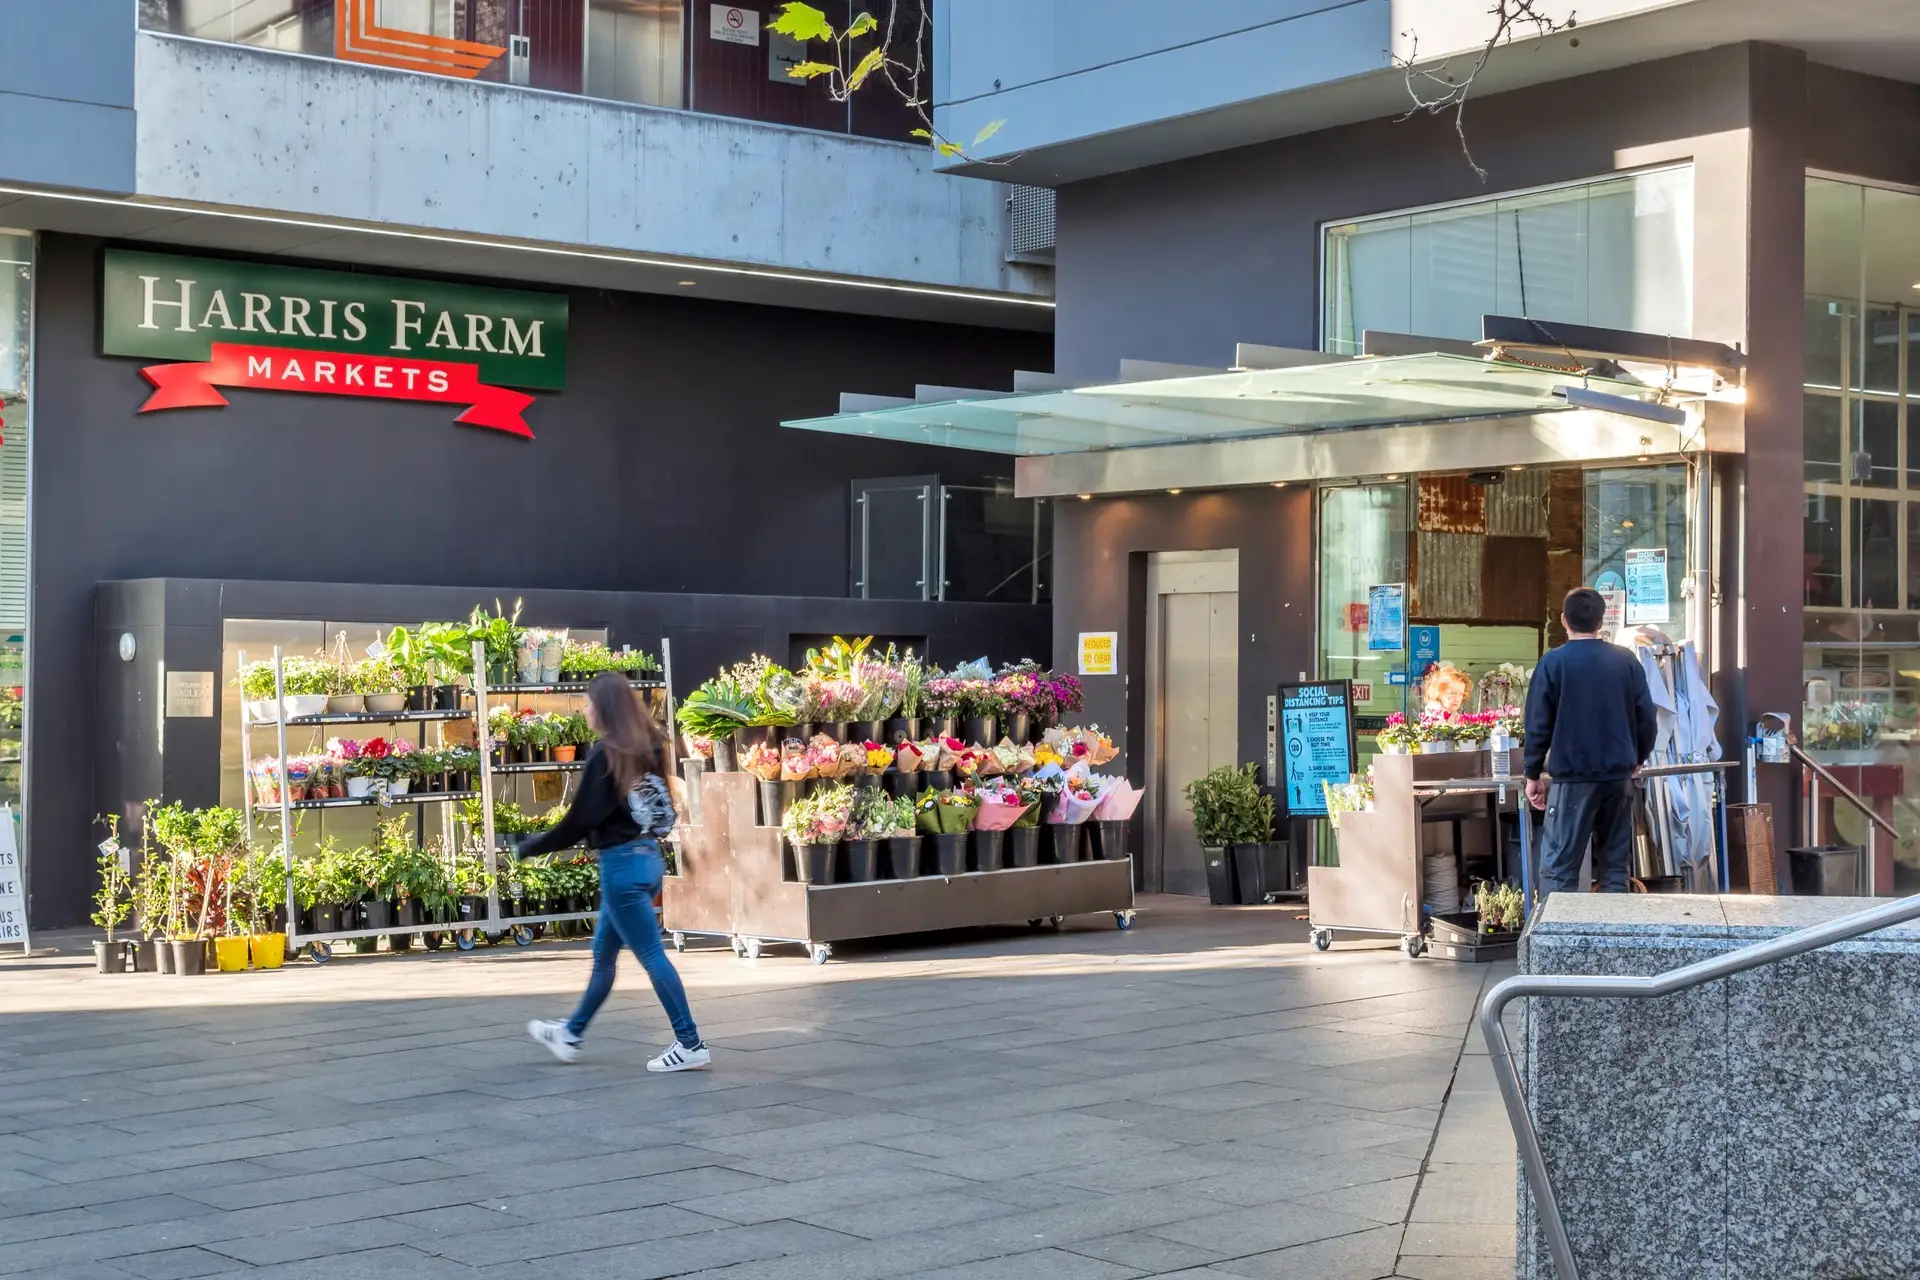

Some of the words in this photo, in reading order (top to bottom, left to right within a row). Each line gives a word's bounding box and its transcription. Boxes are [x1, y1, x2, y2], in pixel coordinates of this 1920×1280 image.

[137, 275, 368, 342] HARRIS
[389, 299, 546, 358] FARM
[248, 355, 449, 394] MARKETS
[1084, 639, 1112, 649] REDUCED
[1084, 654, 1092, 663] TO
[1093, 654, 1111, 663] CLEAR
[1298, 686, 1328, 698] SOCIAL
[1352, 685, 1369, 700] EXIT
[173, 699, 202, 707] STREE
[1284, 696, 1326, 707] DISTANCING
[1327, 695, 1344, 705] TIPS
[1291, 743, 1299, 752] 120
[0, 925, 20, 938] IRS
